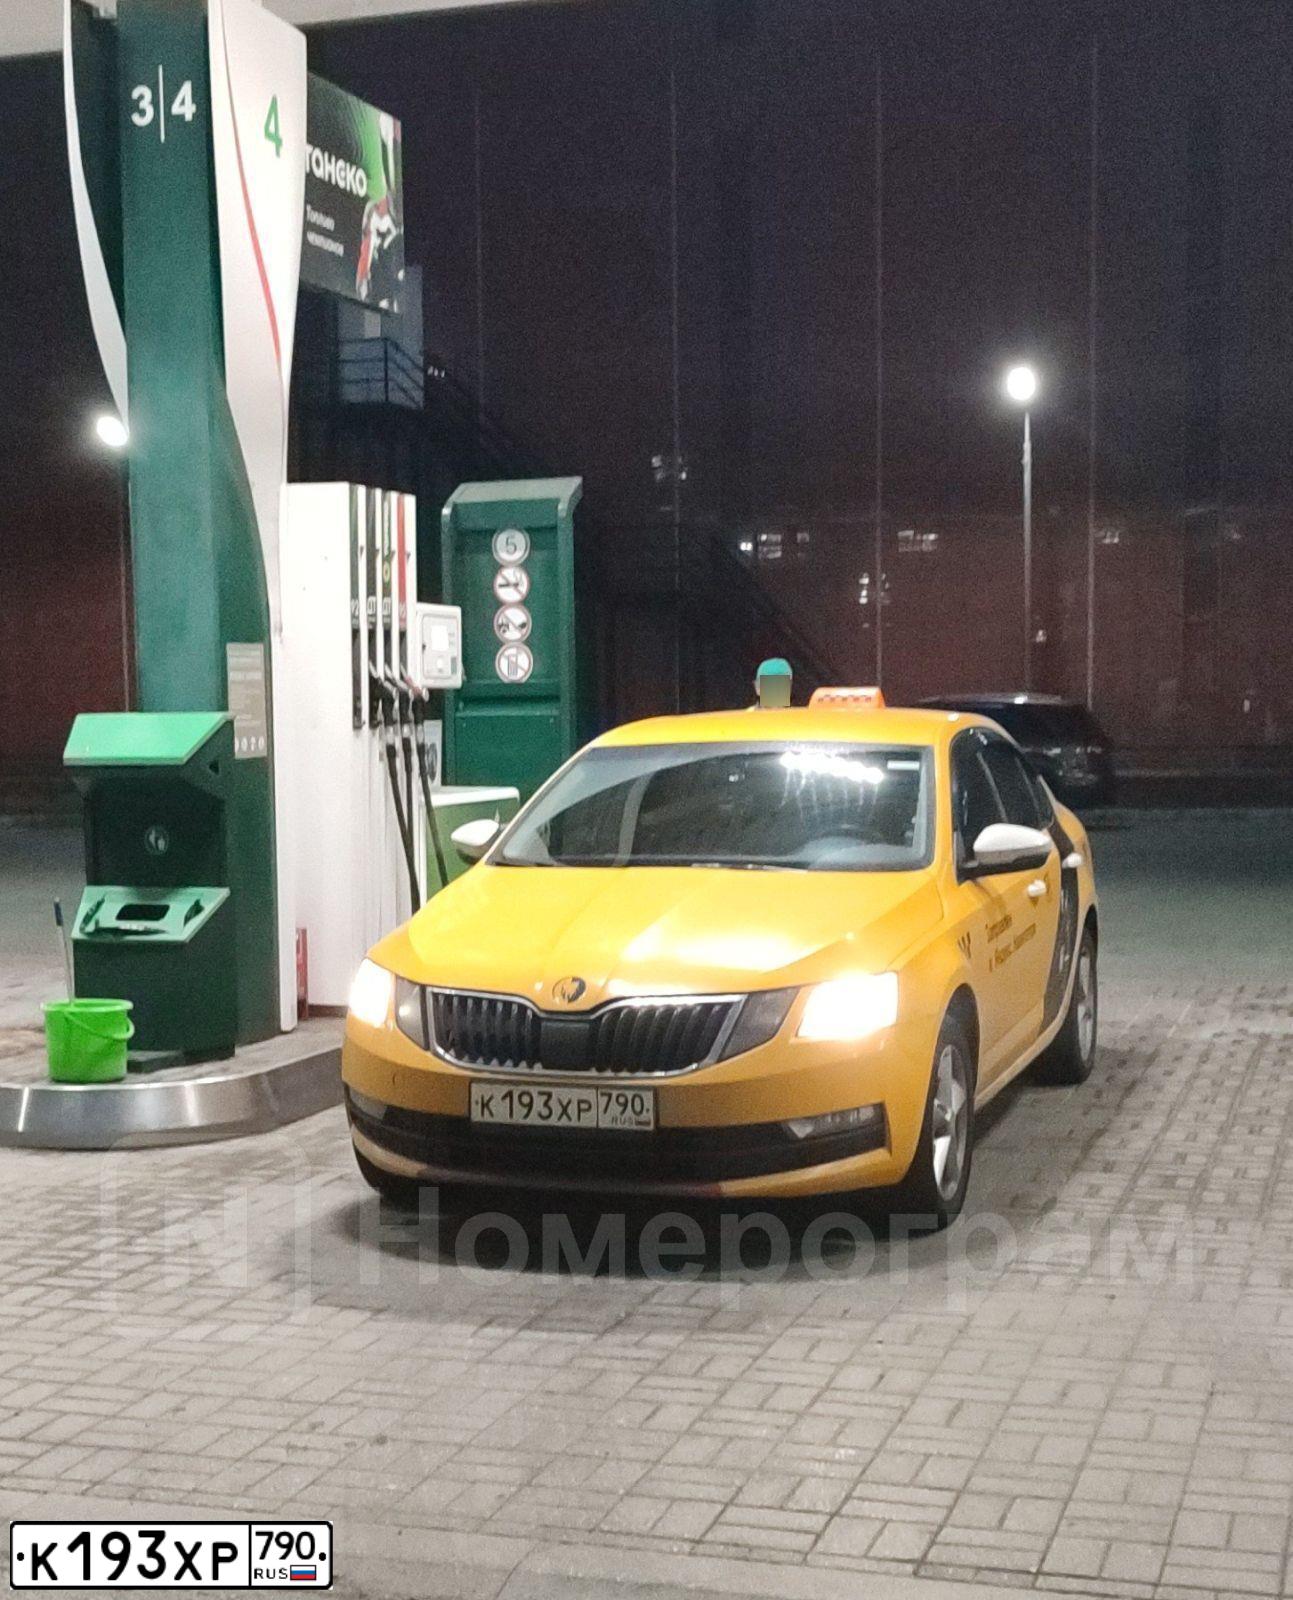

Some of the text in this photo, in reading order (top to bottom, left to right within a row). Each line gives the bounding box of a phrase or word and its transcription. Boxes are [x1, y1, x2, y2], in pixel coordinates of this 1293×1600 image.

[130, 80, 196, 127] 3 4
[264, 94, 283, 158] 4
[480, 1089, 645, 1123] К193ХР 790
